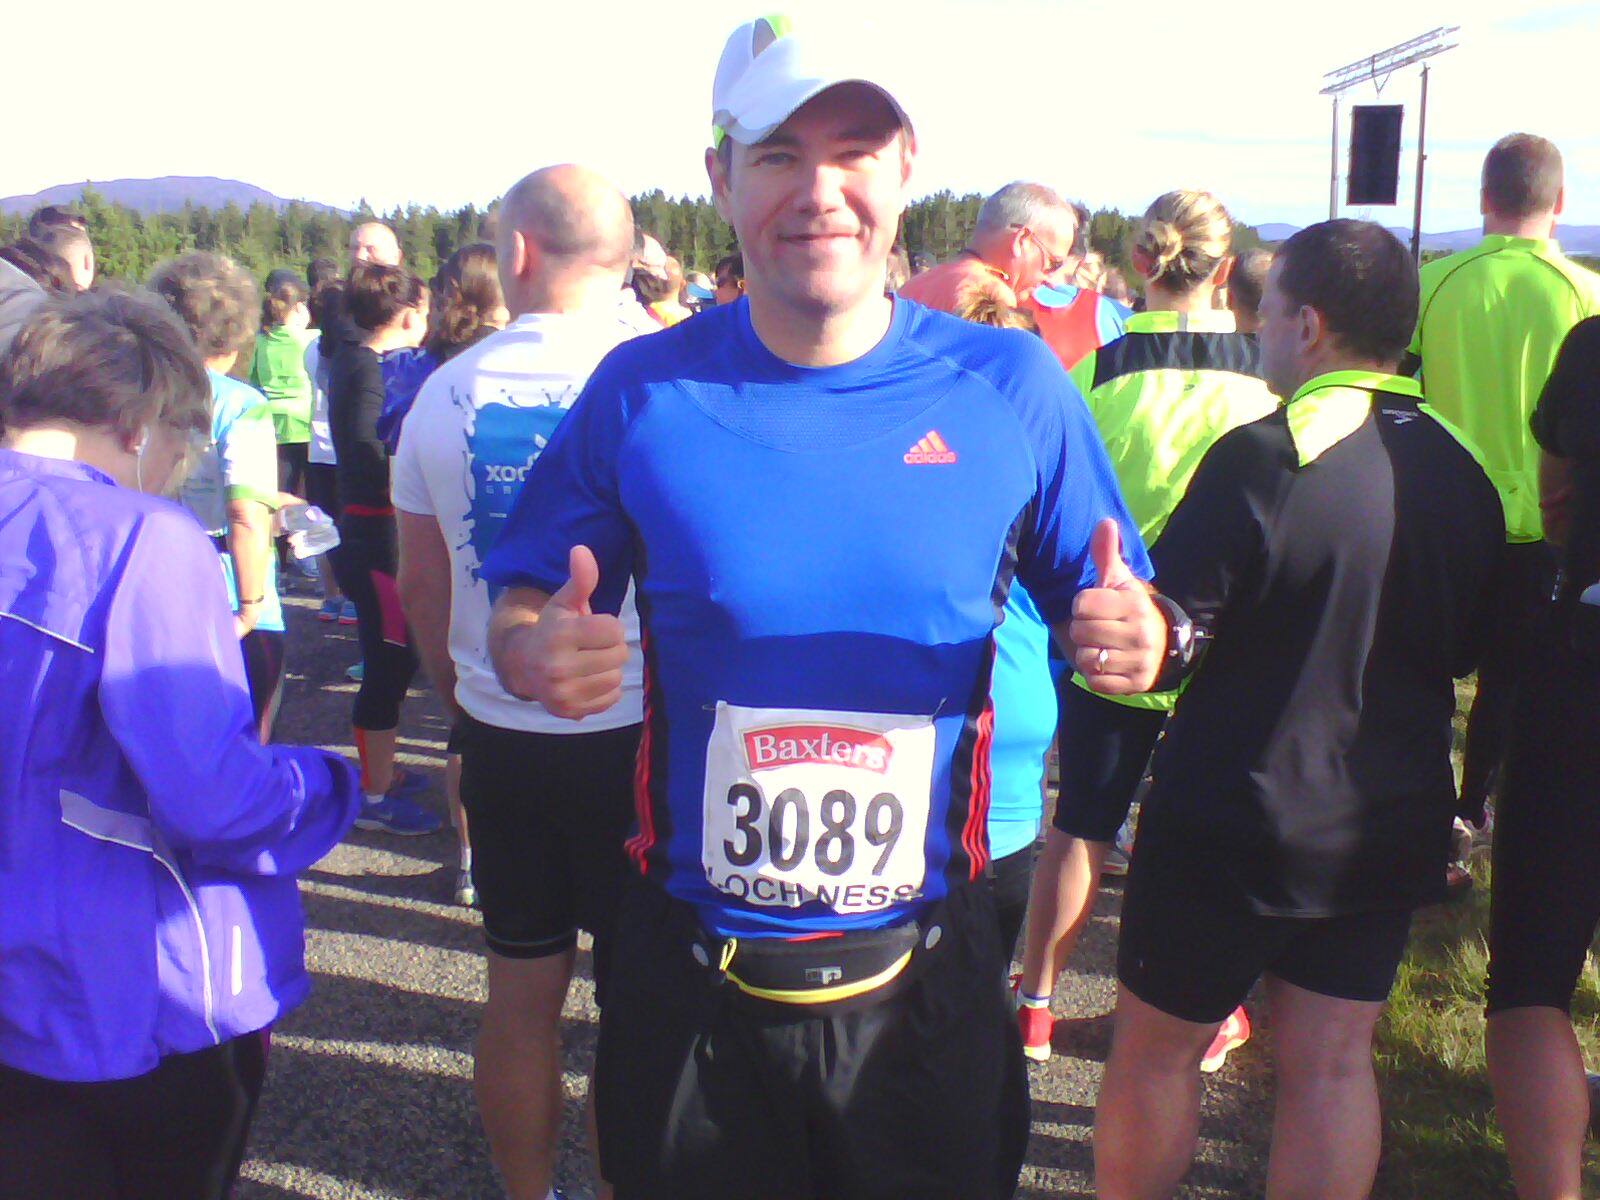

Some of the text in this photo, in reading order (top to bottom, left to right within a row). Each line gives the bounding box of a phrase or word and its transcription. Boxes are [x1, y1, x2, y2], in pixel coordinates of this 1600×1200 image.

[904, 452, 957, 464] adidas
[753, 732, 886, 769] Baxters
[723, 783, 903, 876] 3089
[817, 884, 914, 906] NESS
